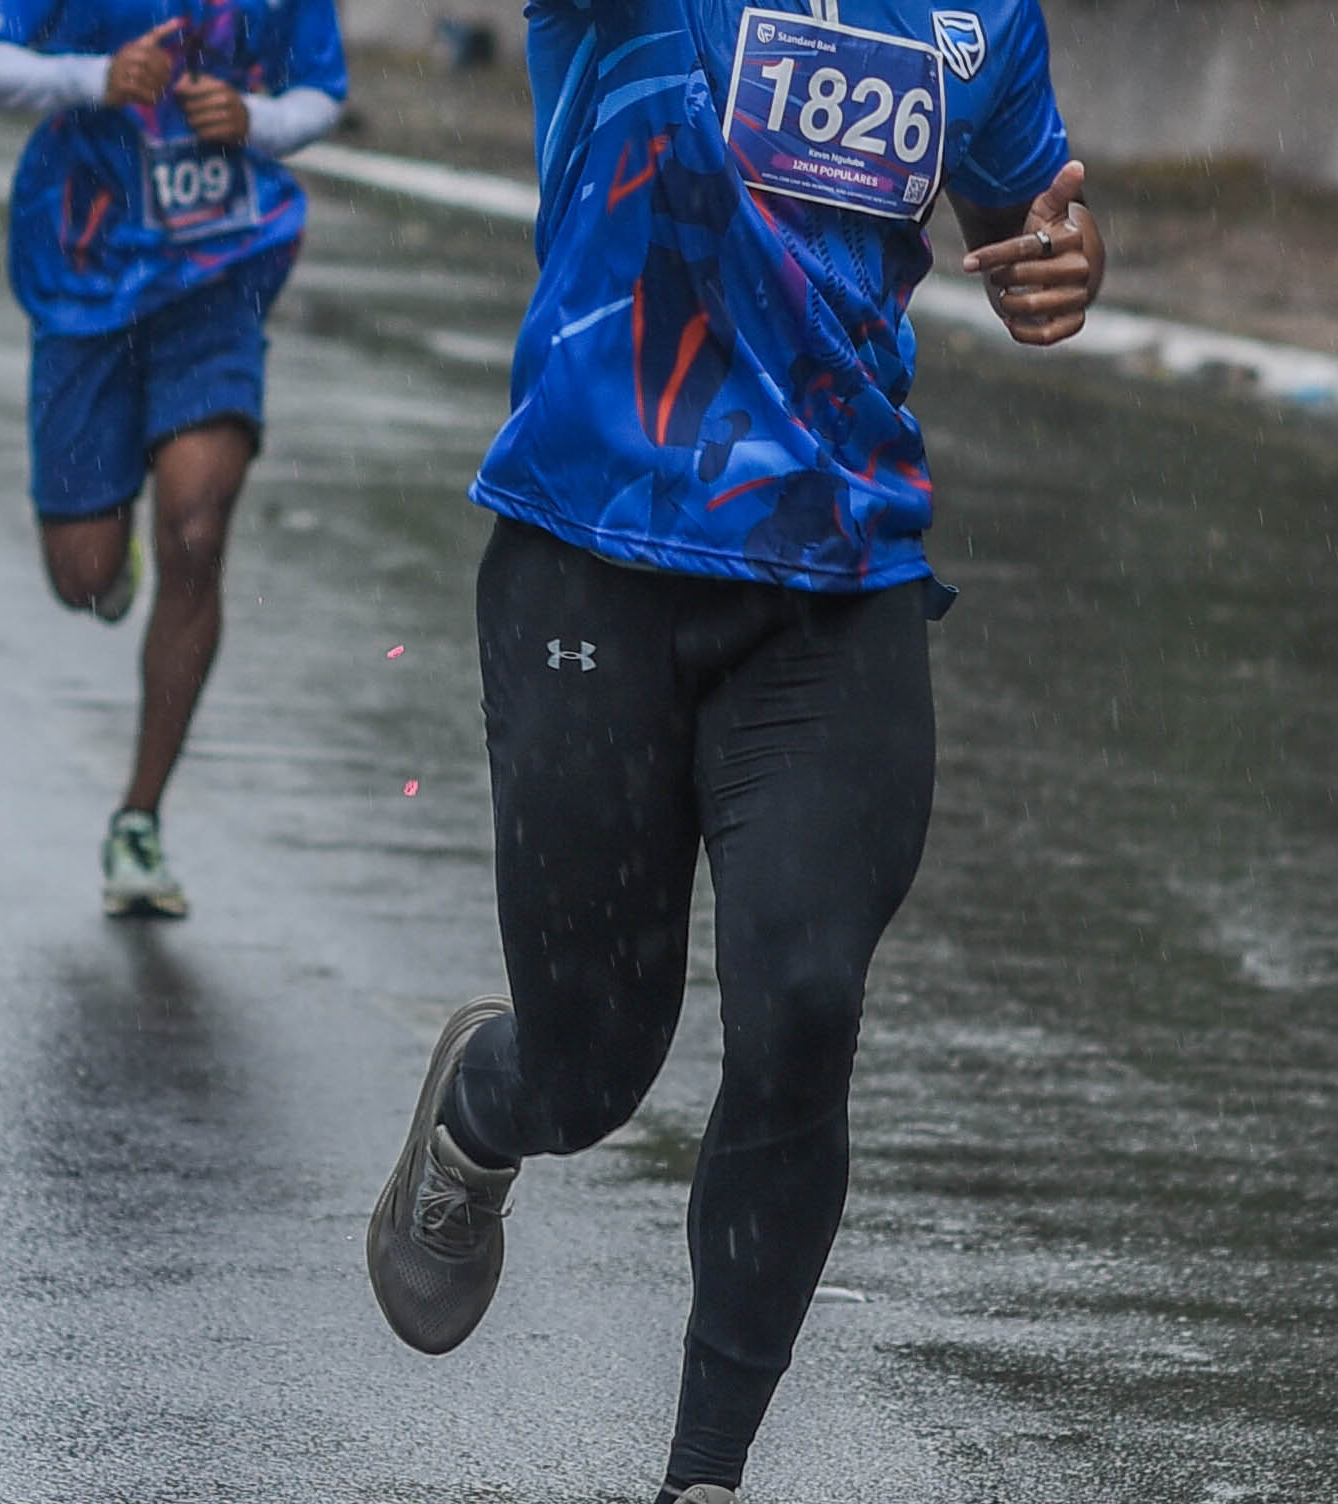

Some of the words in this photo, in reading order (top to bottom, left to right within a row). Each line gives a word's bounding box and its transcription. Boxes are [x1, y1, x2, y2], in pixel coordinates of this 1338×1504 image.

[777, 32, 817, 49] Standard
[817, 40, 837, 53] Bank
[761, 57, 934, 163] 1826
[154, 157, 229, 208] 109
[793, 160, 818, 174] 12KM
[819, 166, 878, 187] POPULARES
